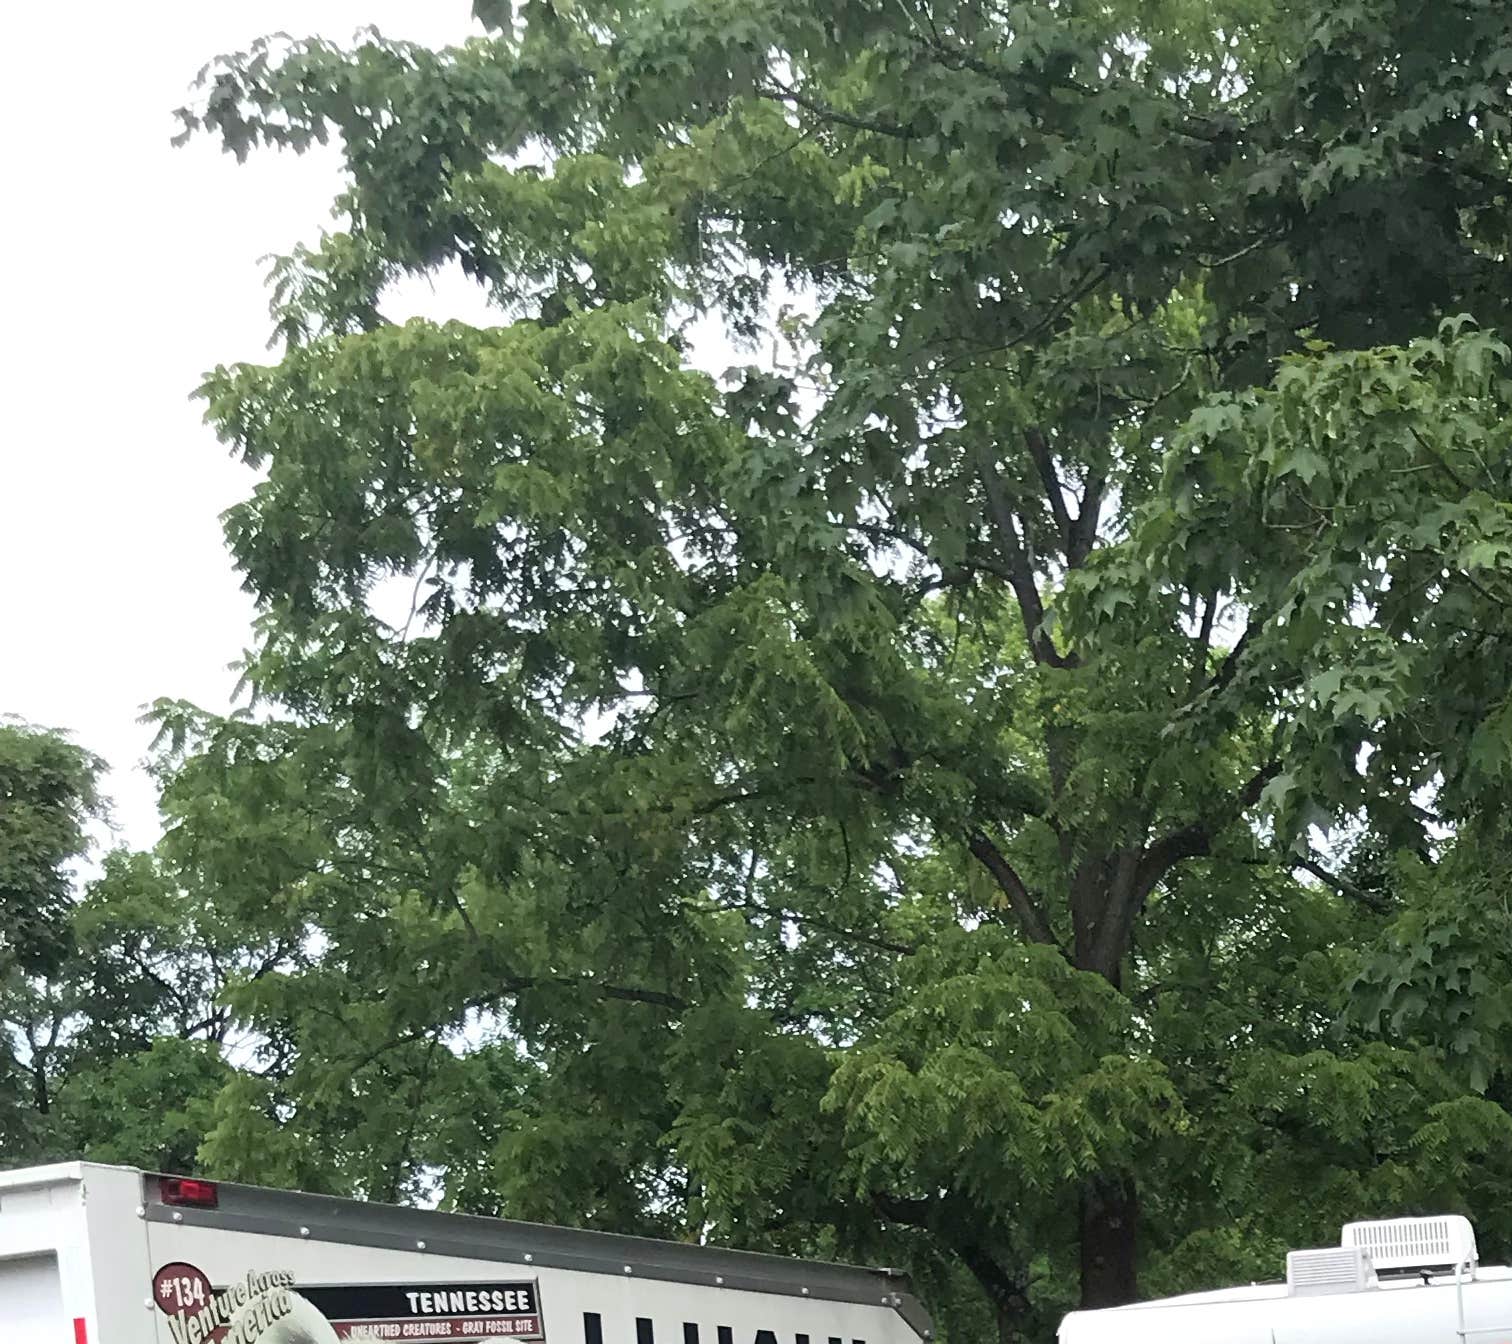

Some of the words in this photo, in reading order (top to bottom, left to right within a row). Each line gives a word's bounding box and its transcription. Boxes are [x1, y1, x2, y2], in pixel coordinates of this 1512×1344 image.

[160, 1277, 205, 1307] #134
[247, 1269, 296, 1298] Across
[406, 1290, 530, 1314] TENNESSEE
[350, 1323, 401, 1338] UNEARTHED
[402, 1322, 452, 1337] CREATURES
[462, 1321, 485, 1335] GRAY
[486, 1320, 514, 1334] FOSSIL
[515, 1319, 533, 1333] SITE
